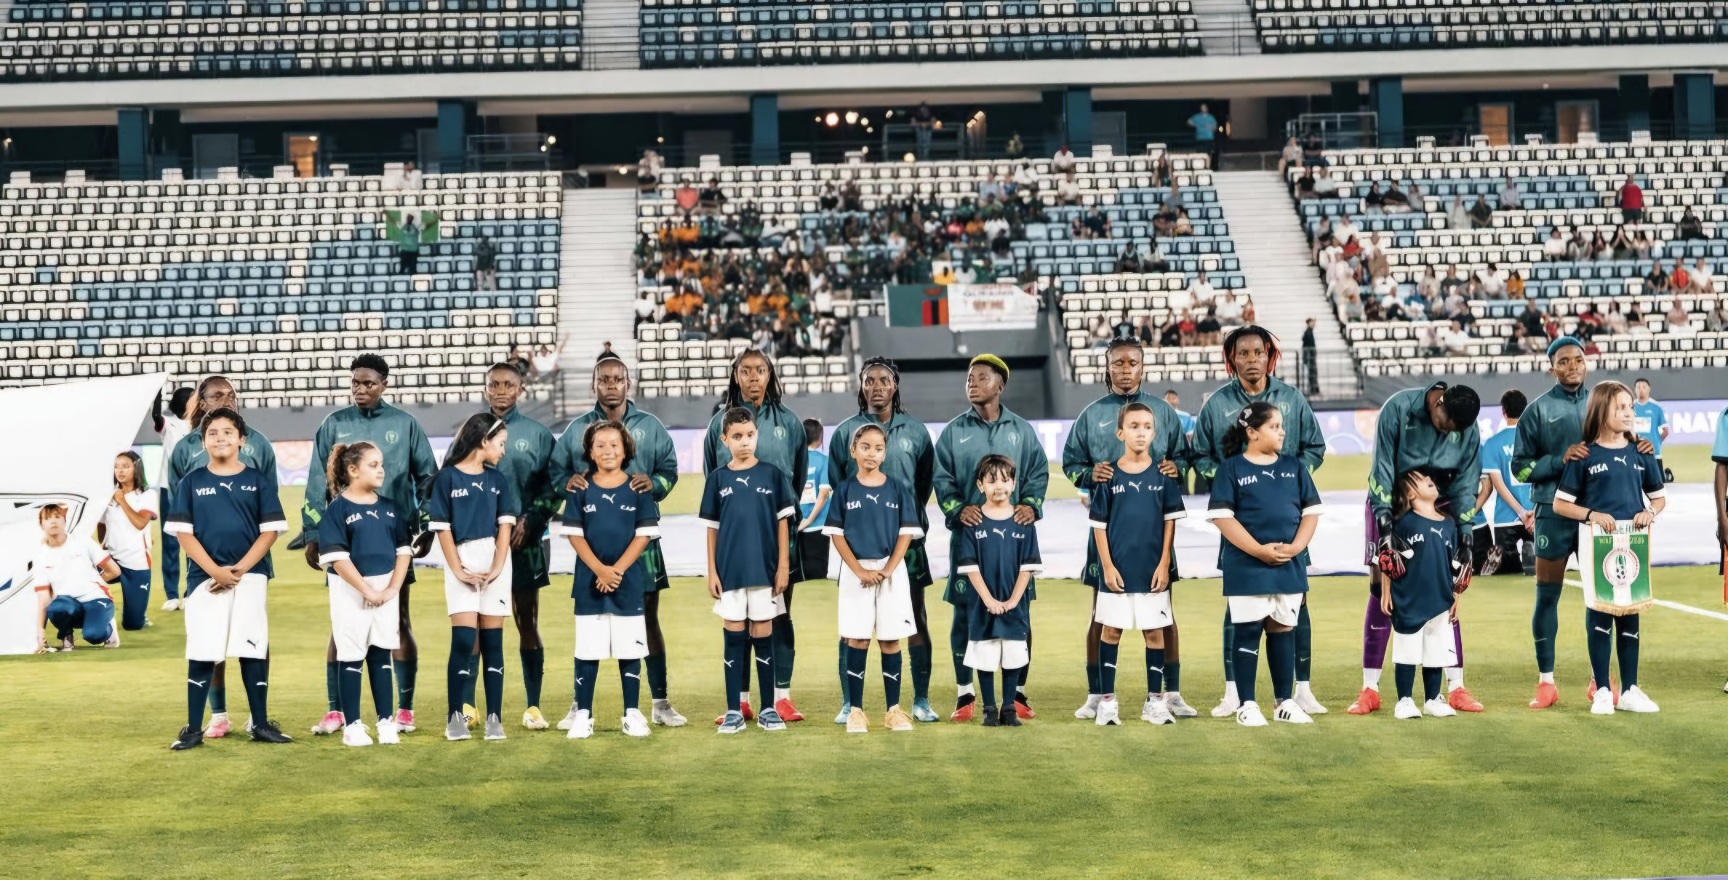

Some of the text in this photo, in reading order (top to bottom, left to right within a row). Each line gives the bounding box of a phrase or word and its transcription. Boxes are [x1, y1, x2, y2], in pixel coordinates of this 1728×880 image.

[1588, 462, 1609, 475] VISA
[1237, 474, 1258, 487] VISA
[195, 486, 217, 497] VISA
